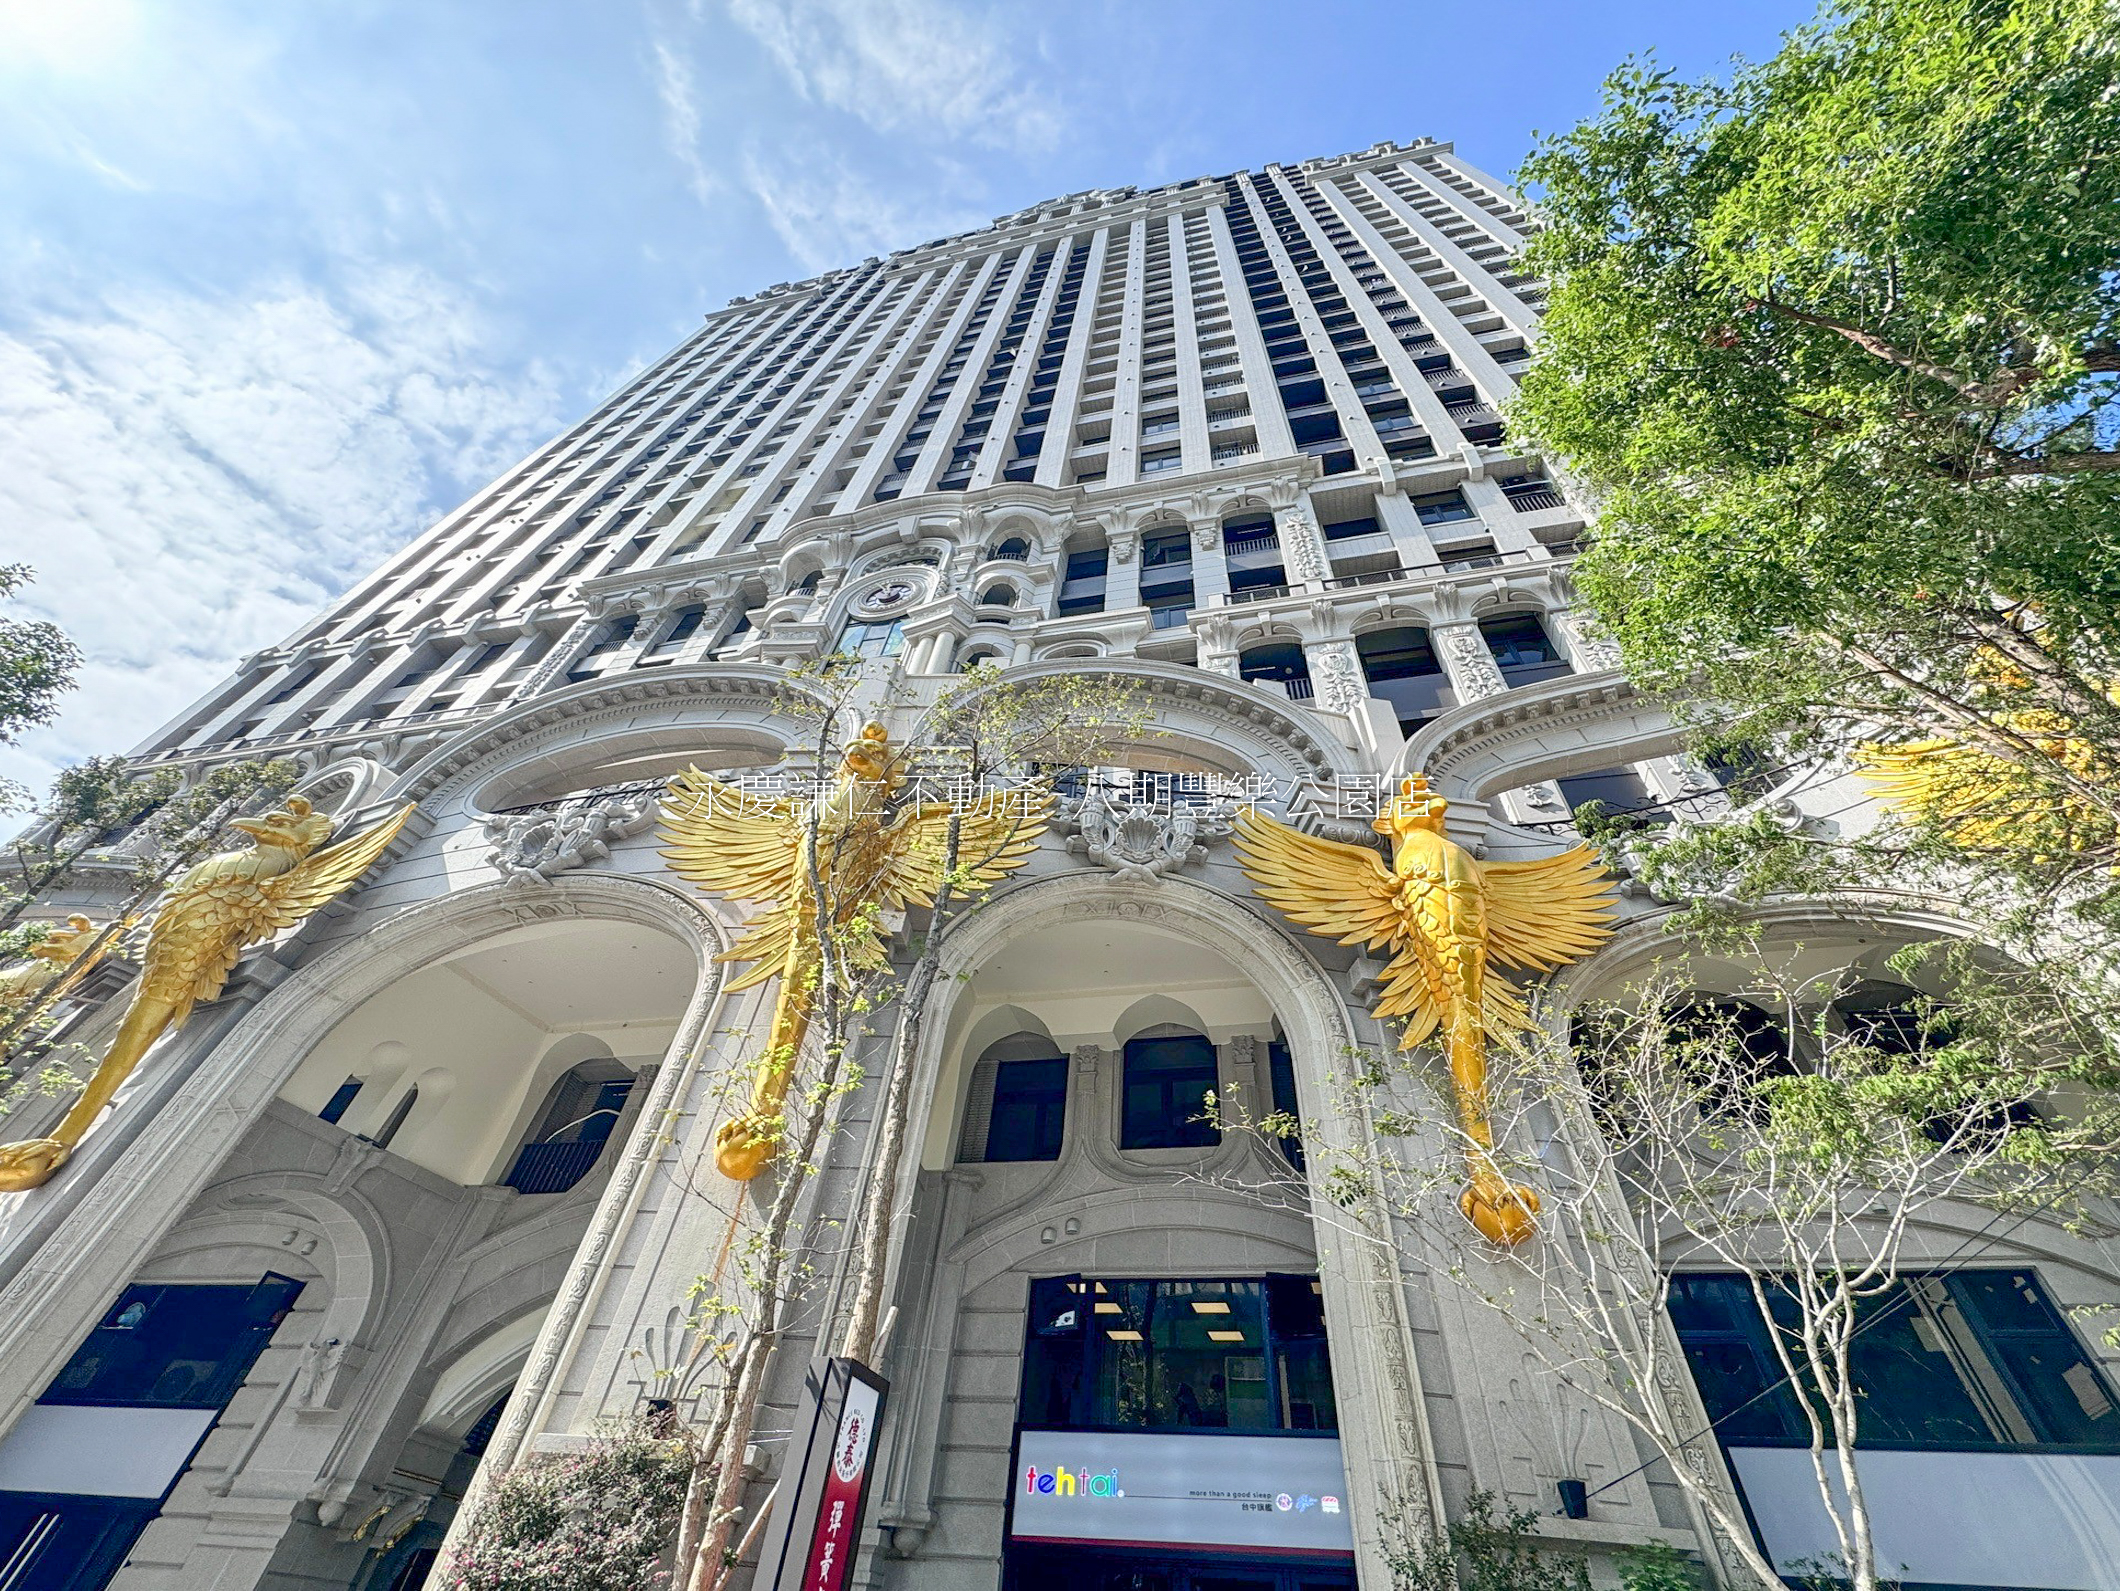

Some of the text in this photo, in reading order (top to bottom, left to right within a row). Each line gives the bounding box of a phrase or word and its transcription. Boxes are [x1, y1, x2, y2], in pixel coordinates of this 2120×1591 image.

[1209, 1489, 1225, 1498] than
[1233, 1490, 1251, 1499] good
[1252, 1491, 1272, 1500] sleep
[818, 1501, 845, 1591] 彈簧
